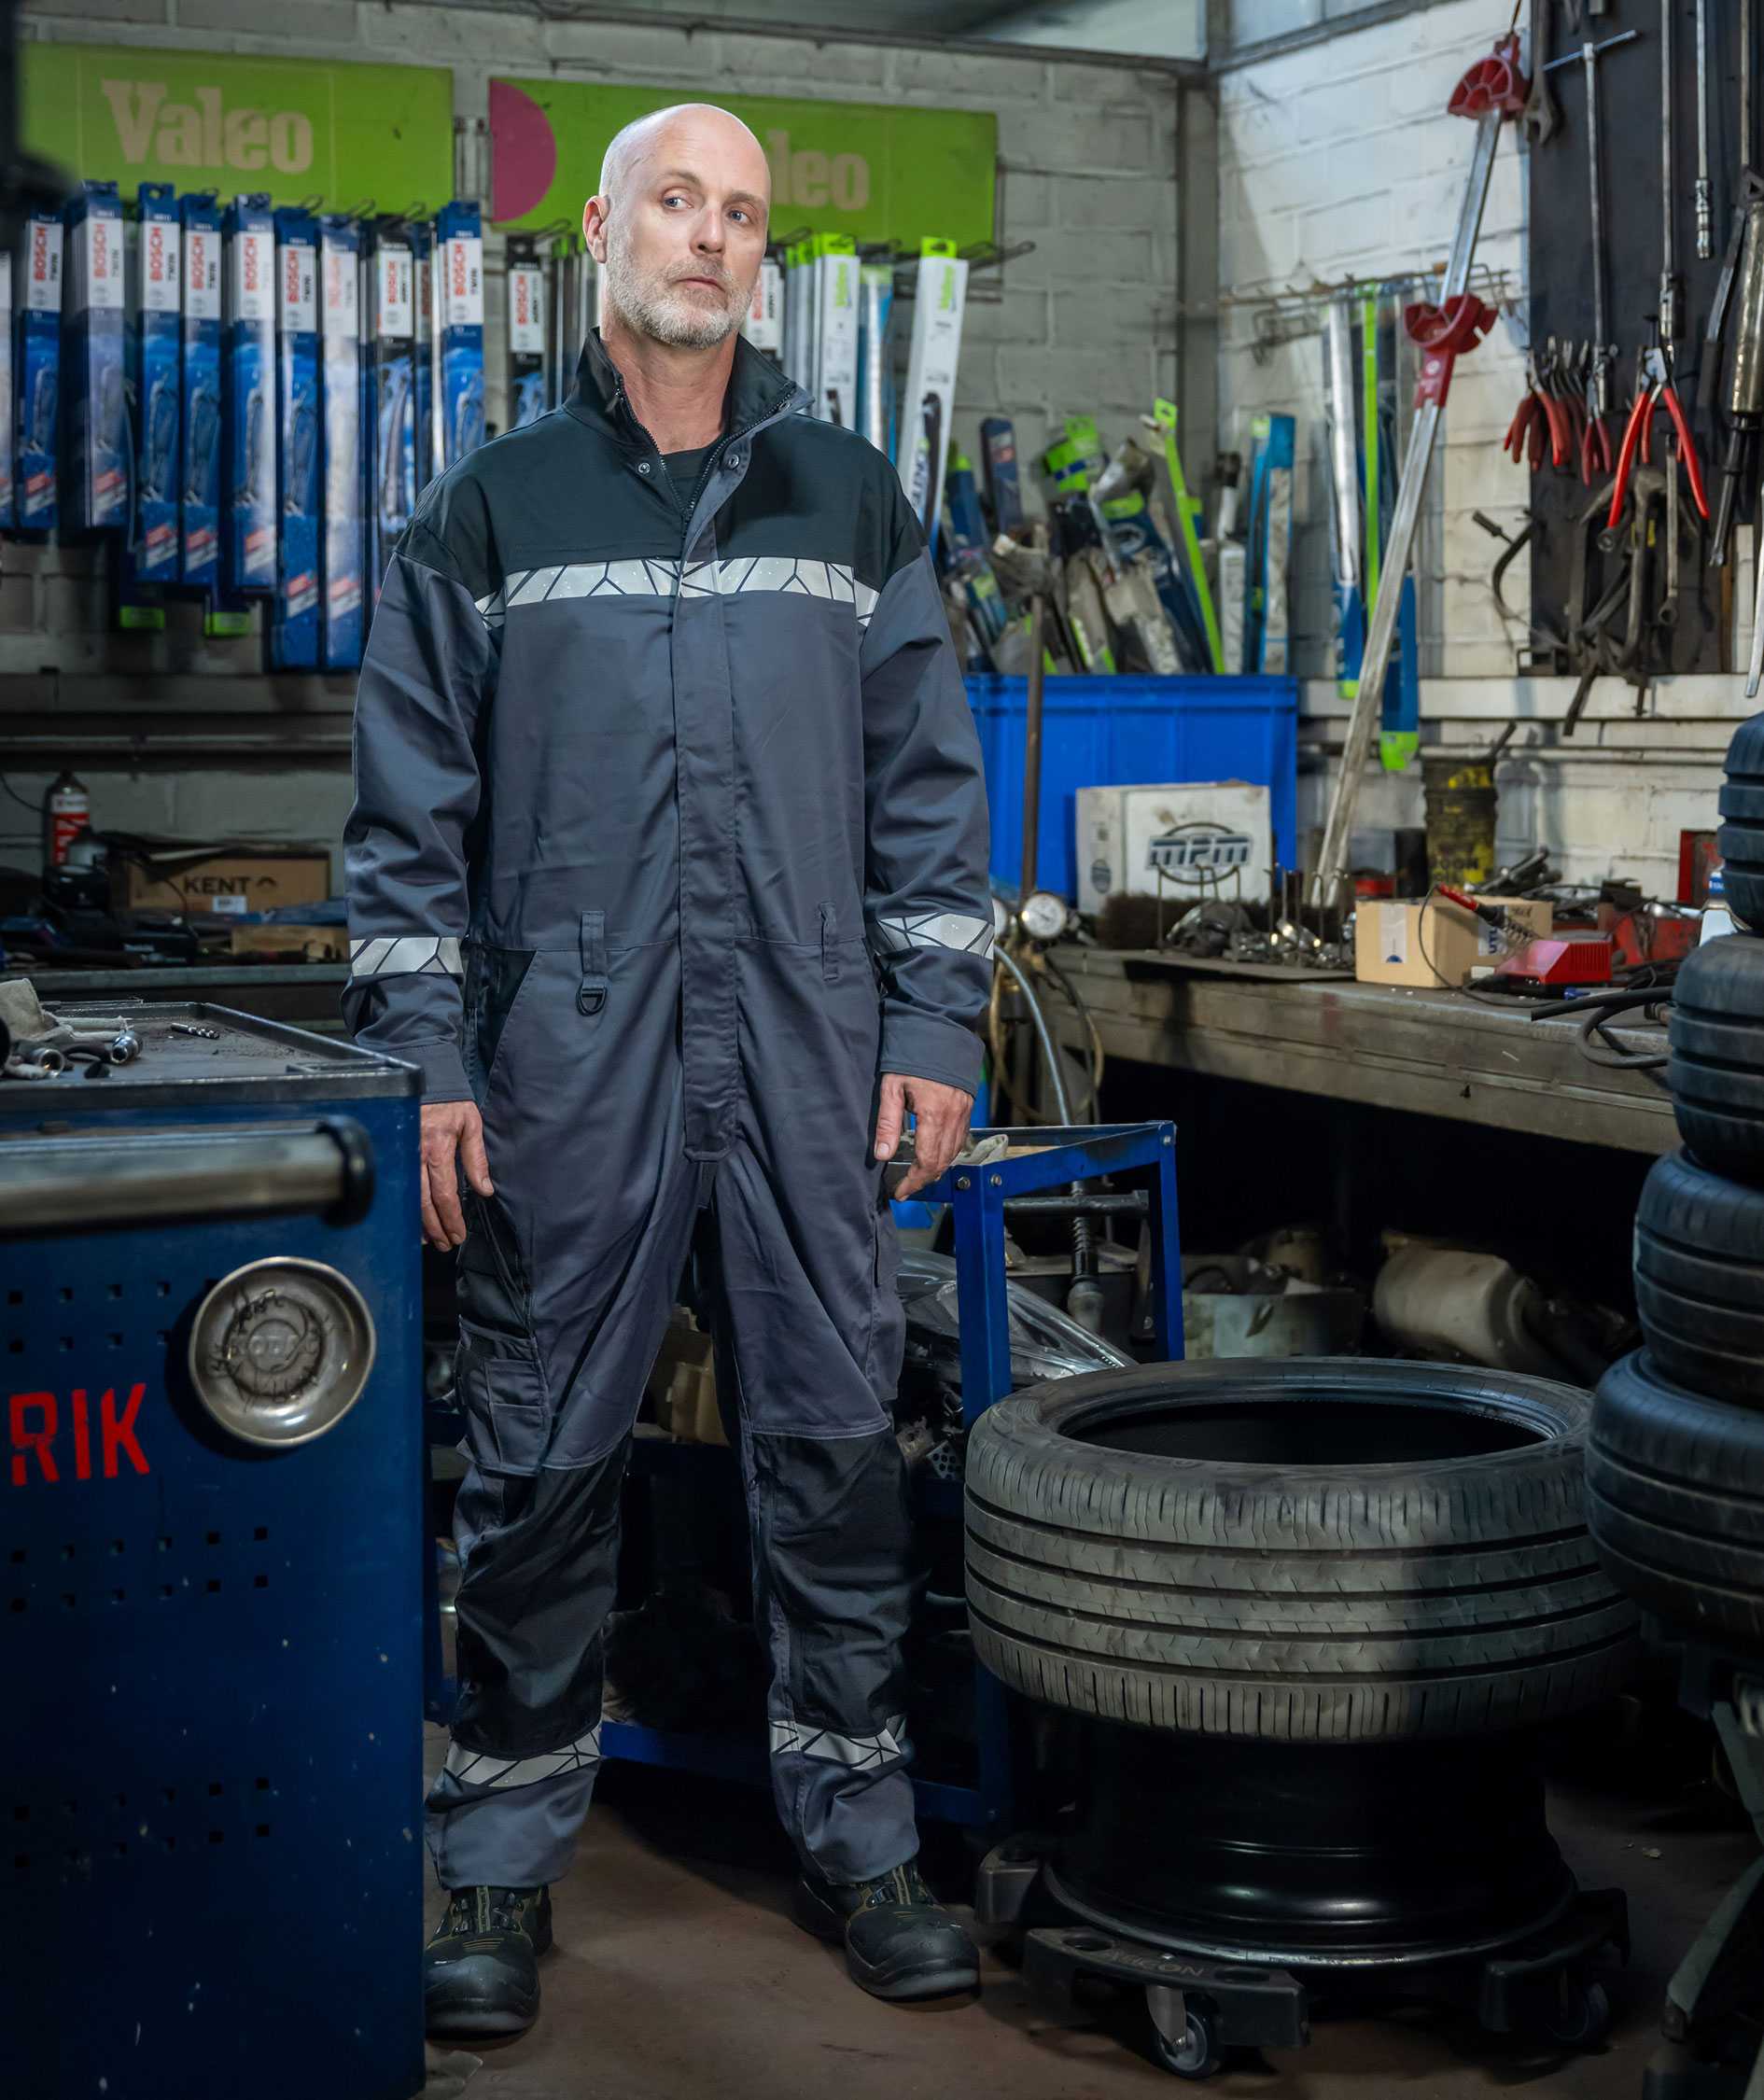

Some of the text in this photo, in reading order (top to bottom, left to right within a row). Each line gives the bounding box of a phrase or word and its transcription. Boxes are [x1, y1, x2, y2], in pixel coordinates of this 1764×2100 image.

[101, 78, 315, 174] Valeo
[767, 129, 870, 212] leo
[34, 226, 48, 282] BOSCH
[94, 223, 106, 279] BOSCH
[150, 226, 162, 282] BOSCH
[191, 235, 204, 290] BOSCH
[245, 236, 257, 291] BOSCH
[287, 249, 300, 303] BOSCH
[454, 244, 466, 297] BOSCH
[387, 260, 398, 305] BOSCH
[516, 274, 528, 325] BOSCH
[183, 875, 251, 894] KENT
[9, 1383, 150, 1486] RIK
